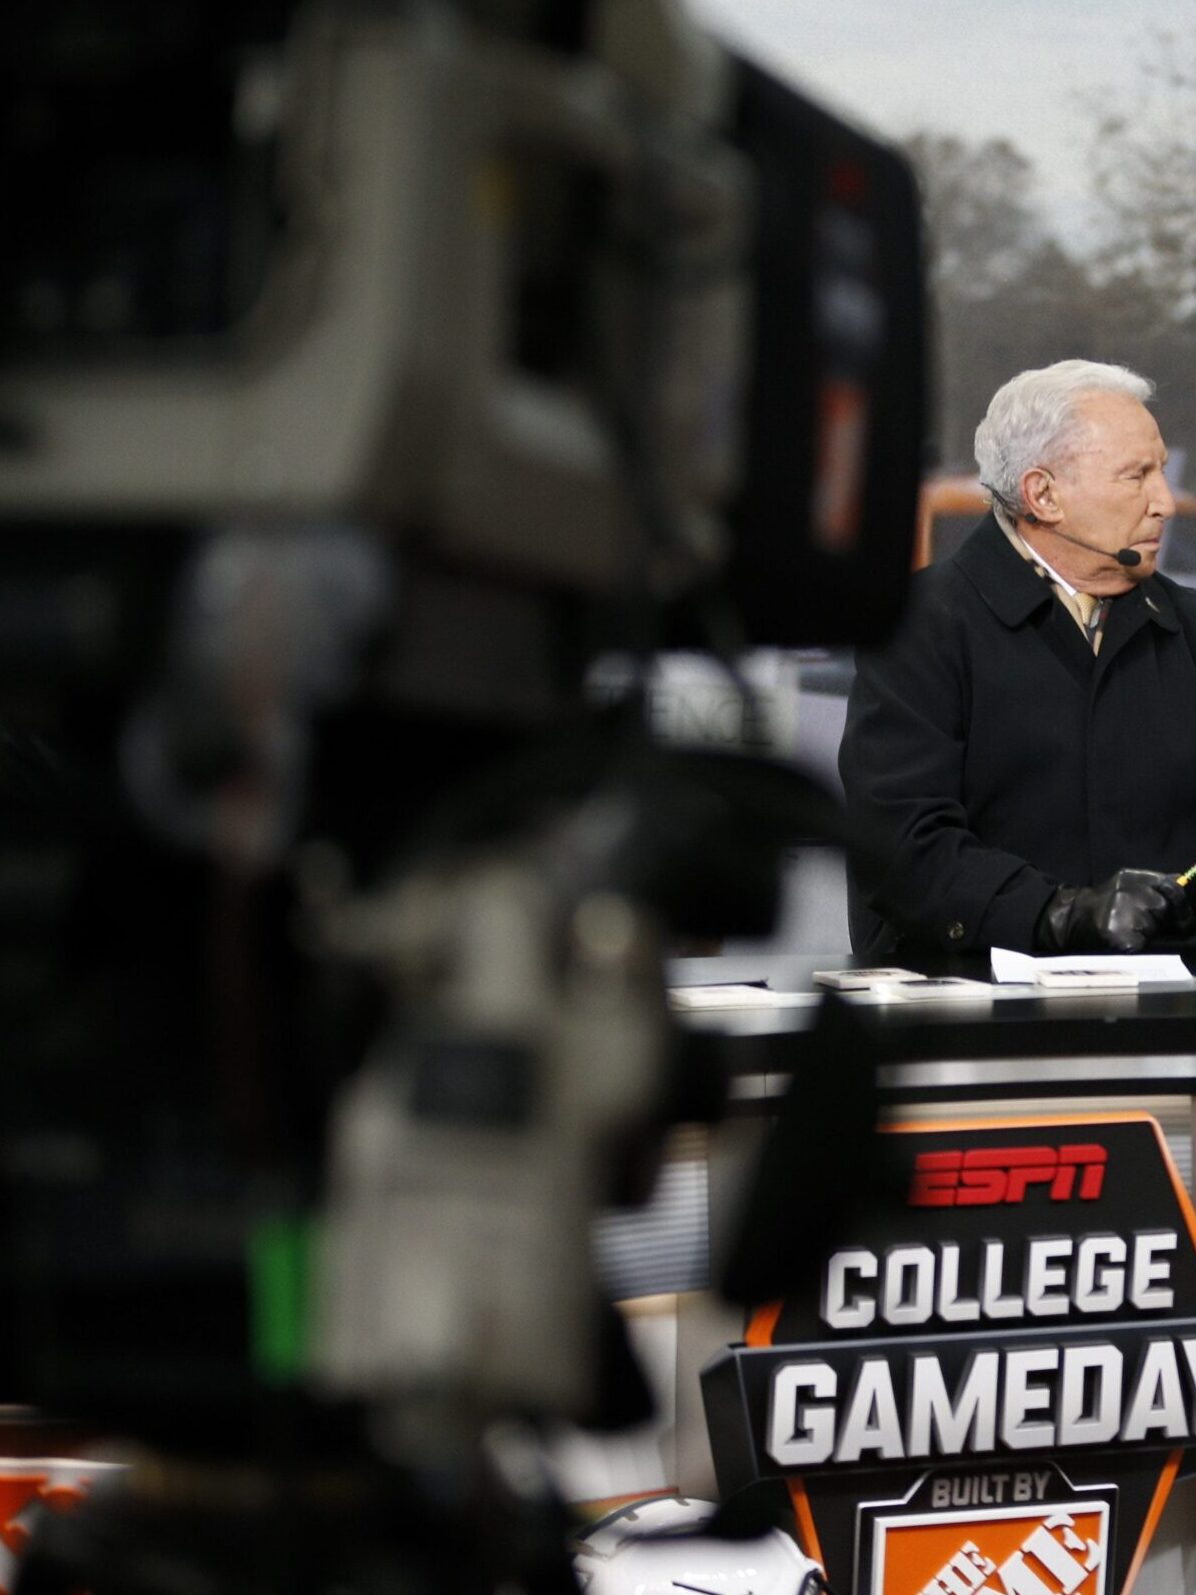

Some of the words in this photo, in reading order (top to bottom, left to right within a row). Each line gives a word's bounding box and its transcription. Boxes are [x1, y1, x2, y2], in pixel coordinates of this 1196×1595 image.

[908, 1143, 1108, 1207] ESPN
[821, 1229, 1178, 1329] COLLEGE
[932, 1475, 1009, 1508] BUILT
[1013, 1471, 1051, 1501] BY
